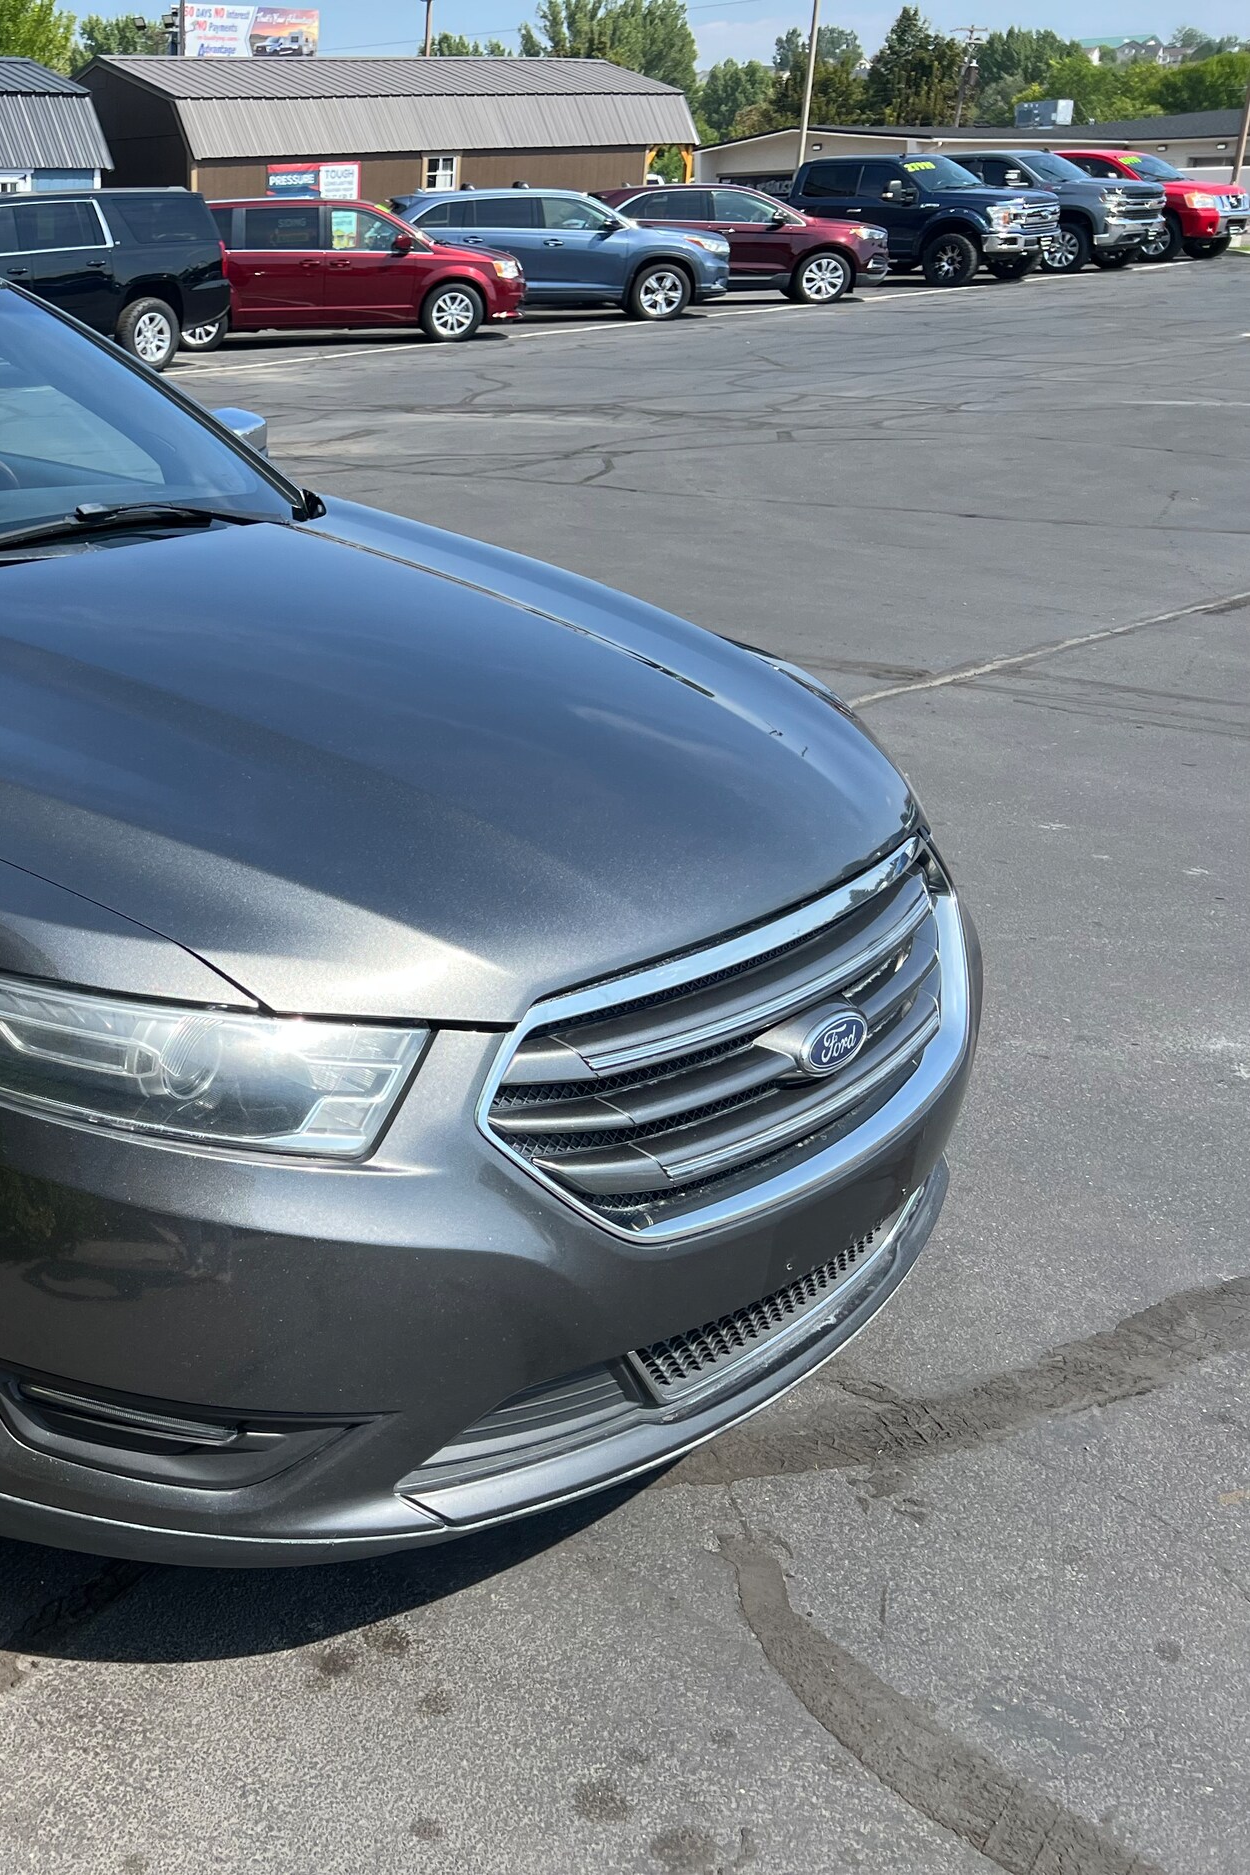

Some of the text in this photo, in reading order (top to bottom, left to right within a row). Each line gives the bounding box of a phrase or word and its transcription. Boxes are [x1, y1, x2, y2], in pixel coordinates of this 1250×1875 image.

[196, 8, 212, 18] DAYS
[214, 7, 225, 19] NO
[226, 11, 250, 20] Interest
[196, 20, 238, 33] NO Payments
[198, 43, 236, 56] Advantage
[269, 174, 315, 186] PRESSURE
[325, 169, 354, 180] TOUGH
[821, 1023, 856, 1063] Ford
